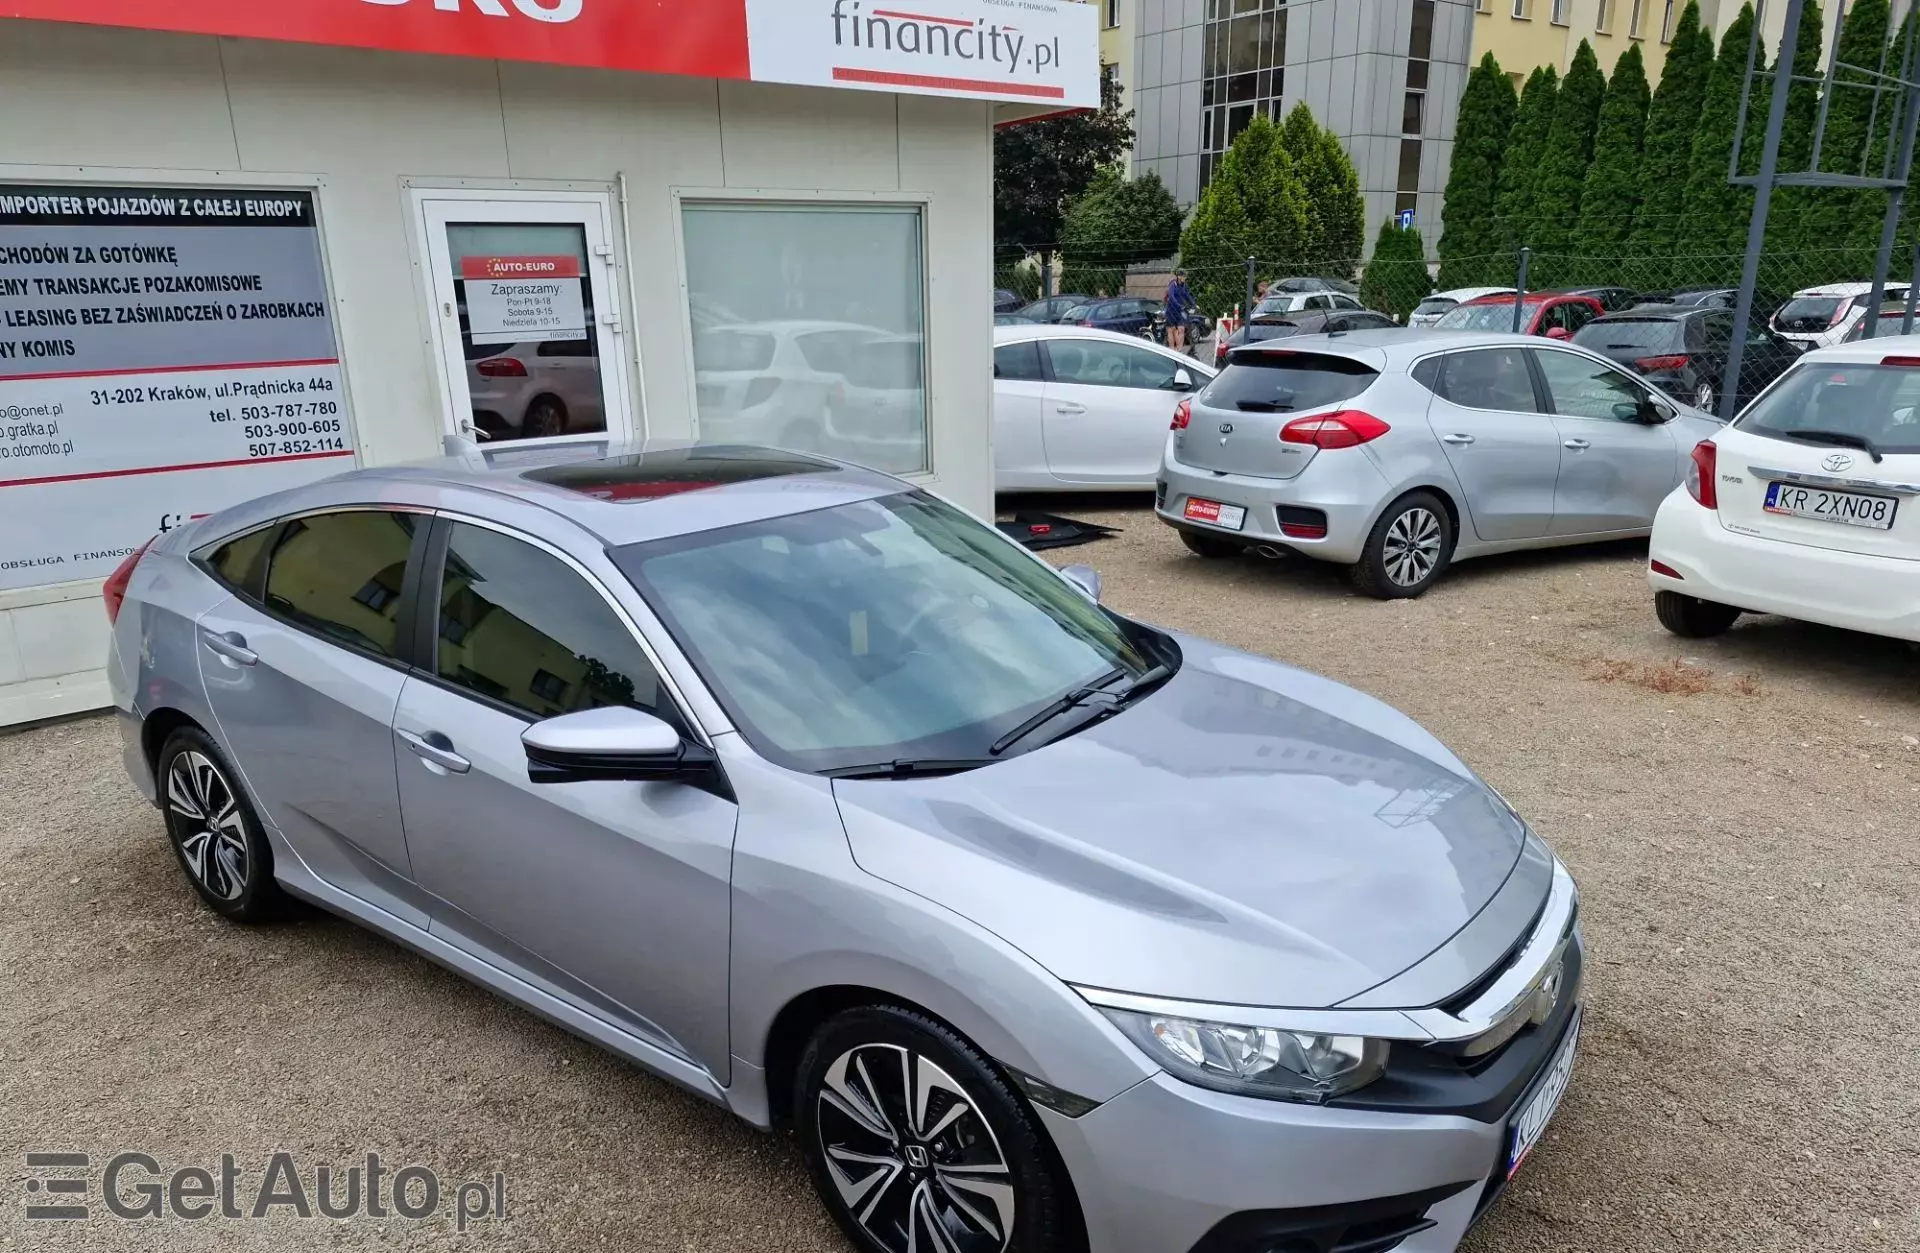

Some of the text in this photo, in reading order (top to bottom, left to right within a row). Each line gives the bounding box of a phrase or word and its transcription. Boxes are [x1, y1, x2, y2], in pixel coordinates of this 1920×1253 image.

[831, 0, 1060, 74] financity.pl
[0, 194, 302, 217] MPORTER POJAZDÓW Z CAŁEJ EUROPY
[73, 247, 97, 264] ZA
[100, 243, 178, 267] GOTÓWKĘ
[494, 262, 555, 272] AUTO-EURO
[33, 277, 141, 296] TRANSAKCJE
[144, 275, 262, 293] POZAKOMISOWE
[5, 301, 325, 327] LEASING BEZ ZAŚWIADCZEŃ O ZAROBKACH
[502, 317, 561, 327] Niedziela 10-15
[507, 307, 553, 317] Sobota 9-15
[22, 339, 76, 358] KOMIS
[90, 377, 334, 405] 31-202 Kraków, ul.Prądnicka 44a
[209, 401, 338, 423] tel. 503-787-780
[244, 419, 341, 439] 503-900-605
[1220, 424, 1233, 433] KIA
[249, 437, 344, 457] 507-852-114
[1780, 488, 1808, 510] KR
[1814, 493, 1887, 521] 2XN08
[1, 547, 136, 570] OBSŁUGA FINANSO
